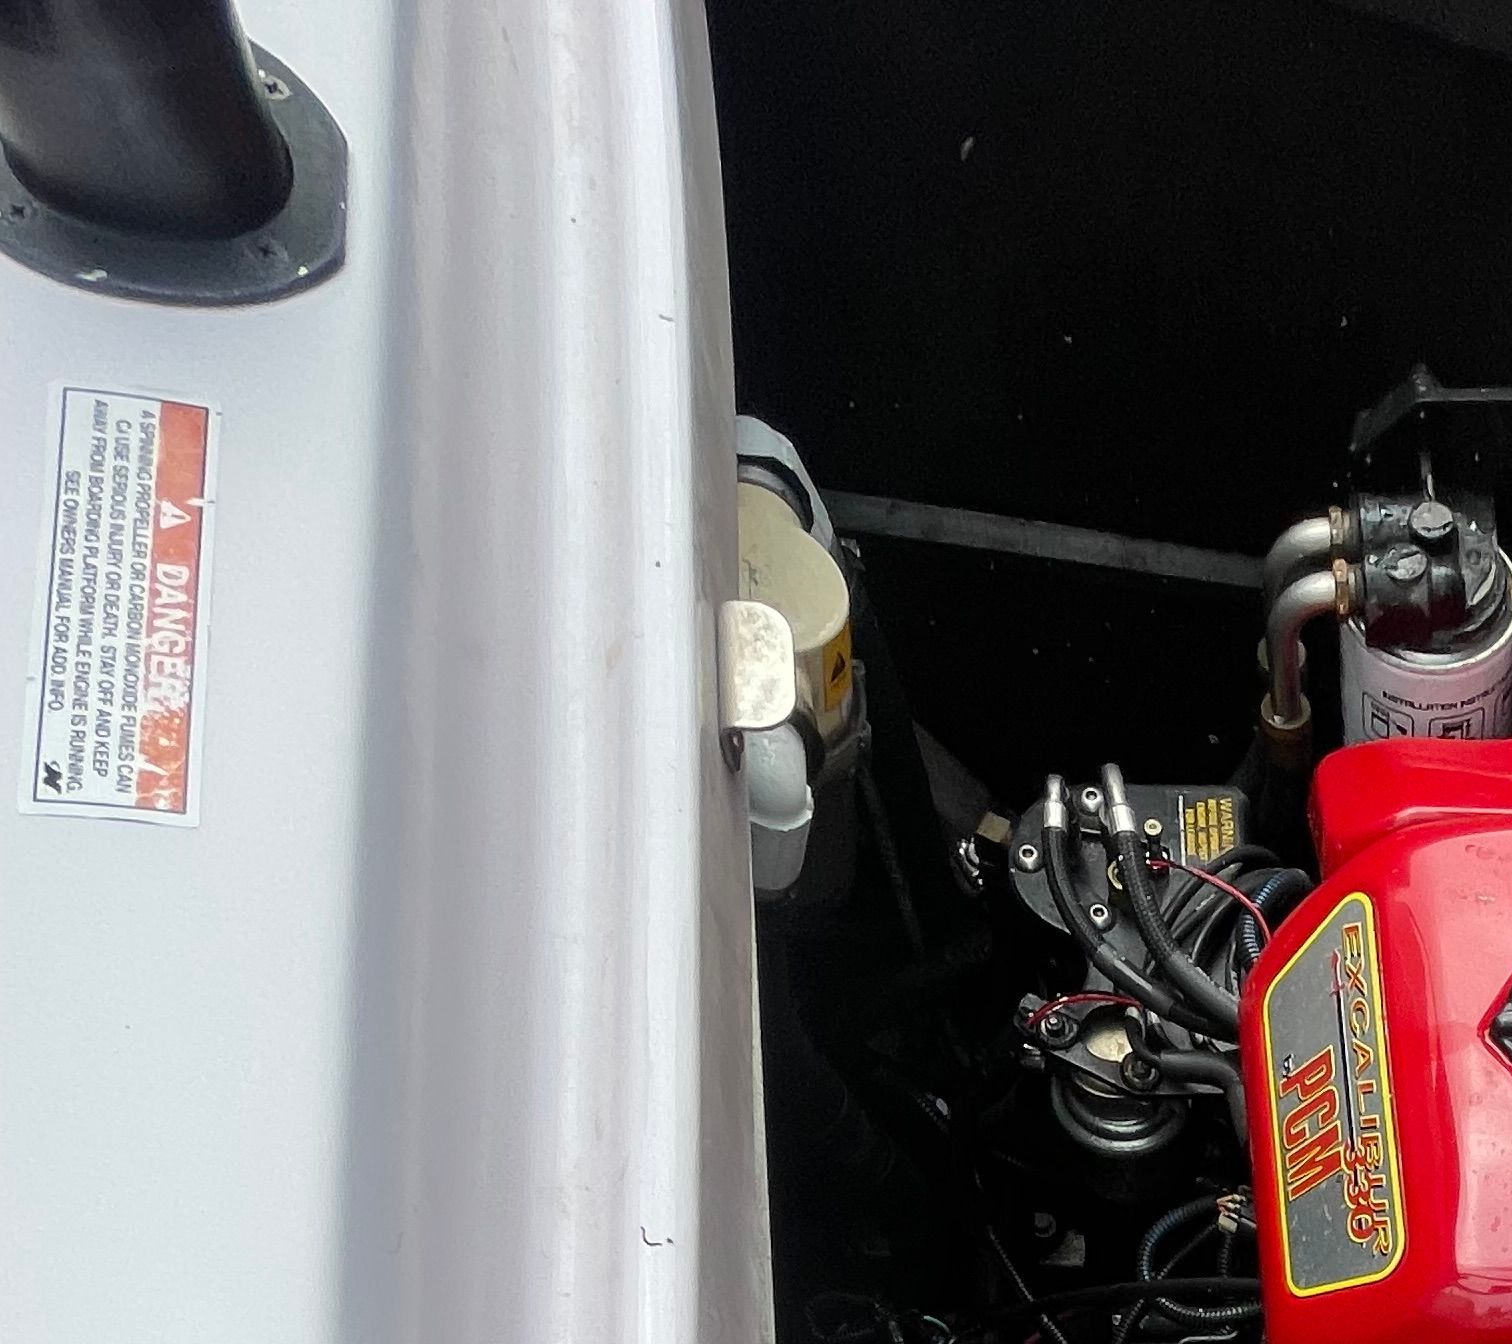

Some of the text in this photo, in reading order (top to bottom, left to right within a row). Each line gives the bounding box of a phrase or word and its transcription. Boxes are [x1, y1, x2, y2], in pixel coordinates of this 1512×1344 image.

[64, 470, 81, 496] SEE
[110, 465, 129, 520] SERIOUS
[60, 499, 79, 554] OWNERS
[107, 523, 125, 569] INJURY
[55, 558, 75, 611] MANUAL
[66, 399, 109, 793] AWAY FROM BOARDING PLATFORM WHILE ENGINE IS RUNNING.
[105, 571, 122, 592] OR
[116, 410, 156, 793] A SPINNING PROPELLER OR CARBON MONOXIDE FUMES CAN
[53, 616, 70, 643] FOR
[101, 594, 119, 639] DEATH.
[147, 563, 190, 708] DANGER
[50, 646, 67, 677] ADD.
[100, 645, 117, 677] STAY
[97, 680, 114, 706] OFF
[95, 709, 112, 738] AND
[93, 741, 109, 777] KEEP
[1341, 920, 1391, 1258] EXCALIBUR
[1279, 1044, 1341, 1202] PCM
[1338, 1138, 1375, 1244] 330
